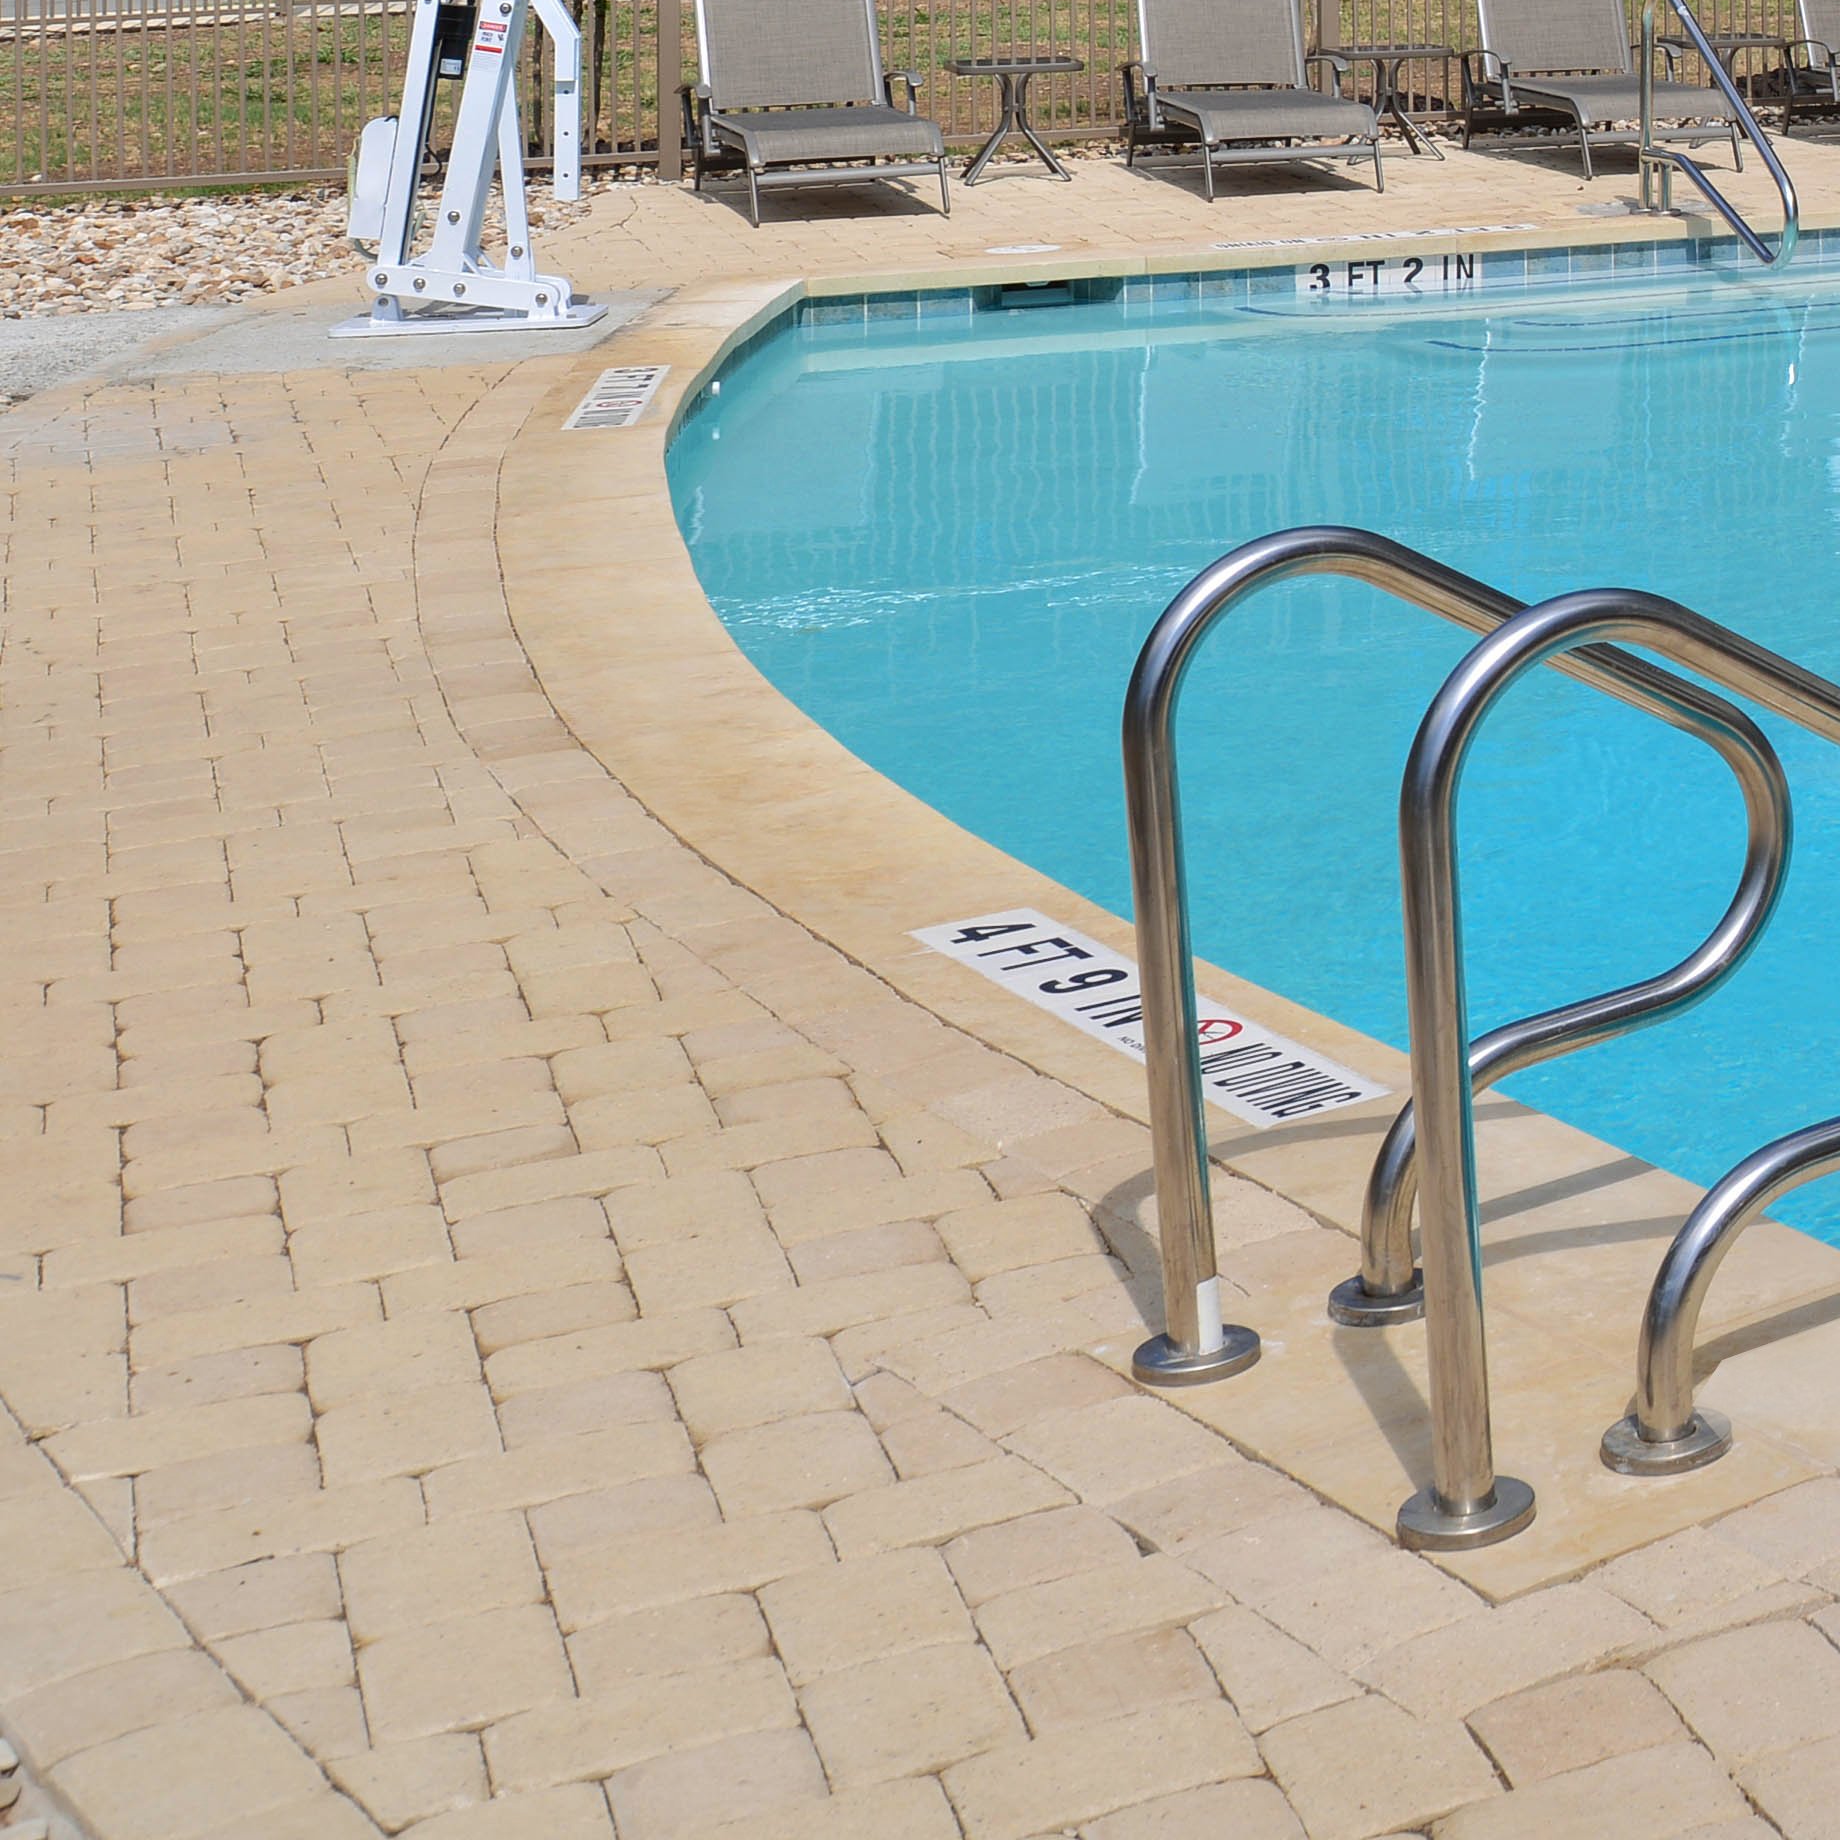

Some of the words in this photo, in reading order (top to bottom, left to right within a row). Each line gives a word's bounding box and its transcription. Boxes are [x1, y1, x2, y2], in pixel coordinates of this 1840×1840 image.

[1310, 263, 1330, 290] 3
[1349, 260, 1385, 287] FT
[1402, 257, 1424, 283] 2
[1443, 254, 1474, 281] IN
[950, 923, 1036, 944] 4
[977, 937, 1094, 970] FT
[1039, 969, 1128, 994] 9
[1200, 1043, 1283, 1075] NO
[1213, 1061, 1362, 1118] DIVING
